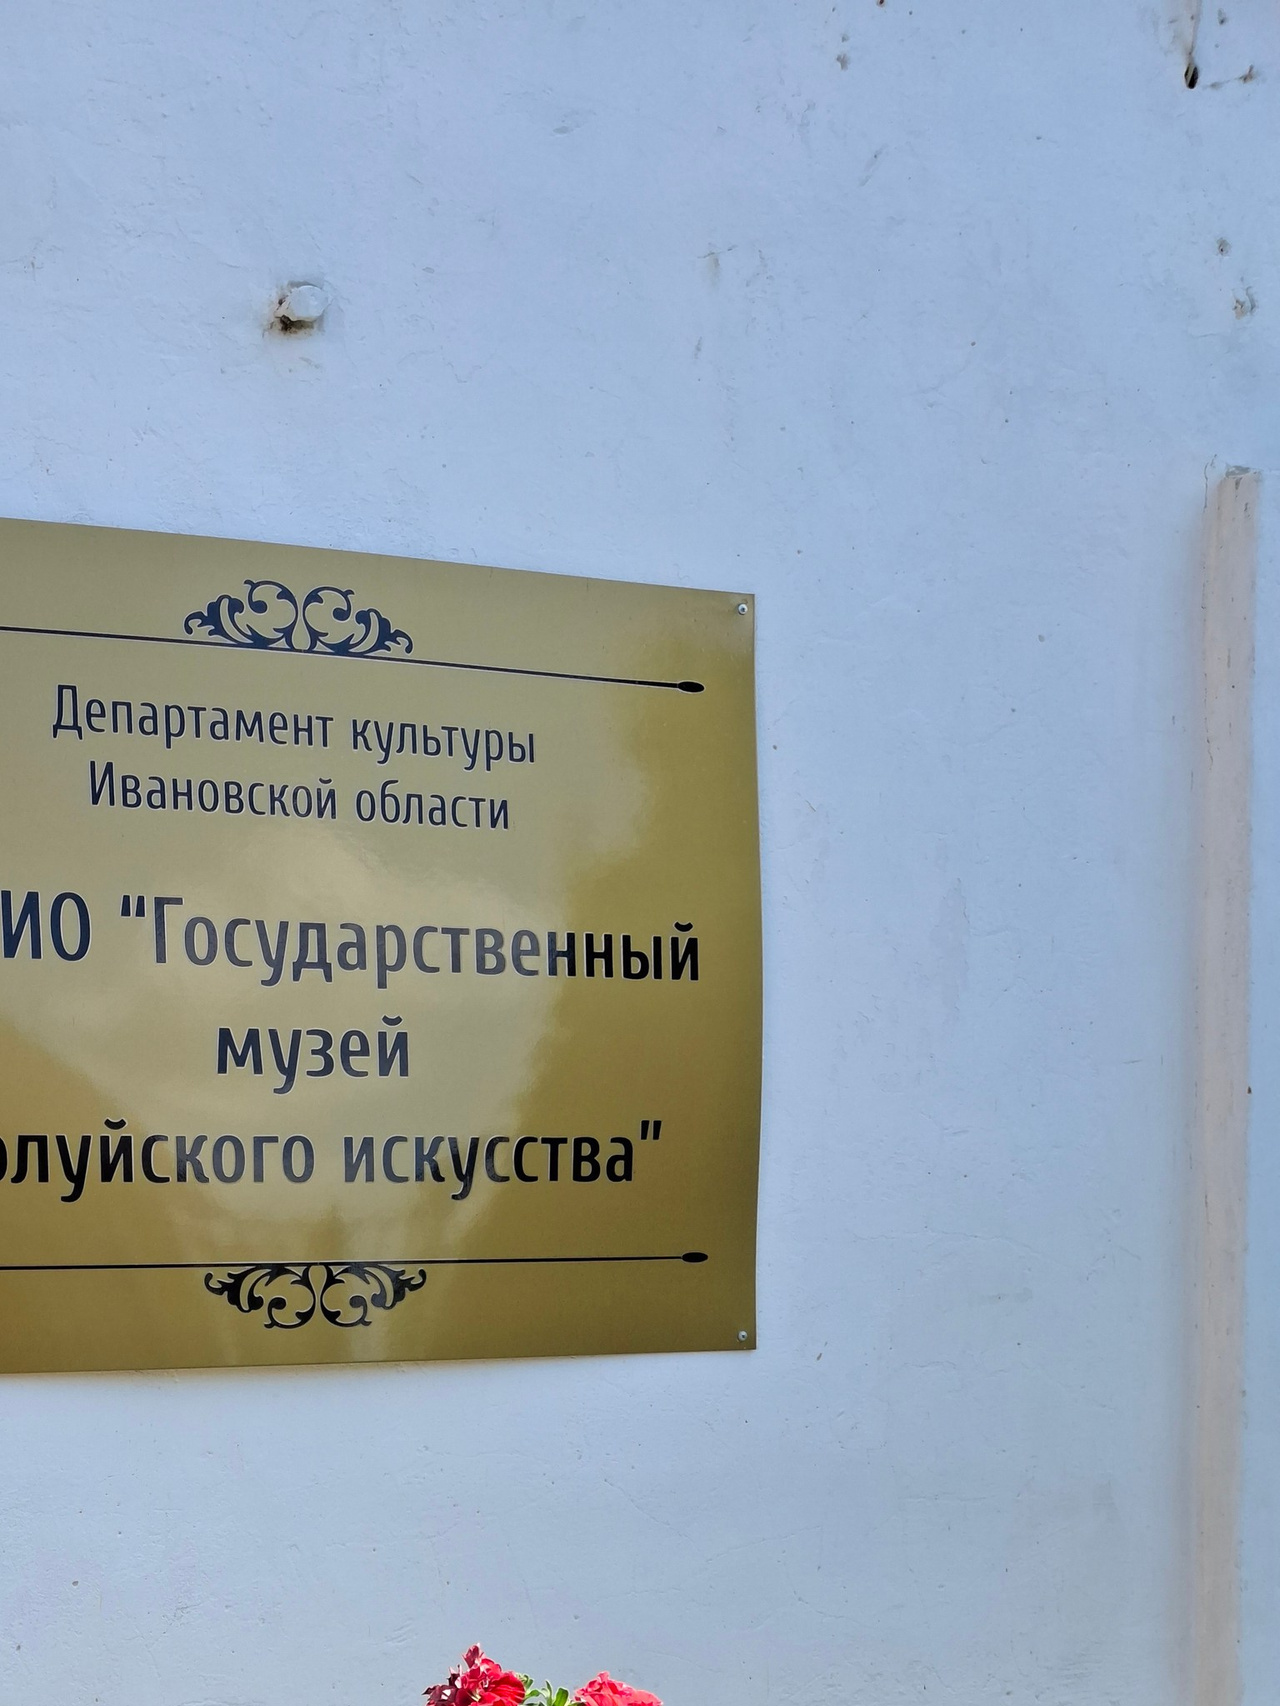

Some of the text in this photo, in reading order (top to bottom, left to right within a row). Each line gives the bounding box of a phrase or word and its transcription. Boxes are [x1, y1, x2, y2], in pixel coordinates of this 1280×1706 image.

[52, 684, 536, 773] Департамент культуры
[89, 760, 510, 831] Ивановской области
[120, 894, 700, 989] “Государственный
[216, 1014, 410, 1096] музей
[343, 1119, 664, 1202] искусства”
